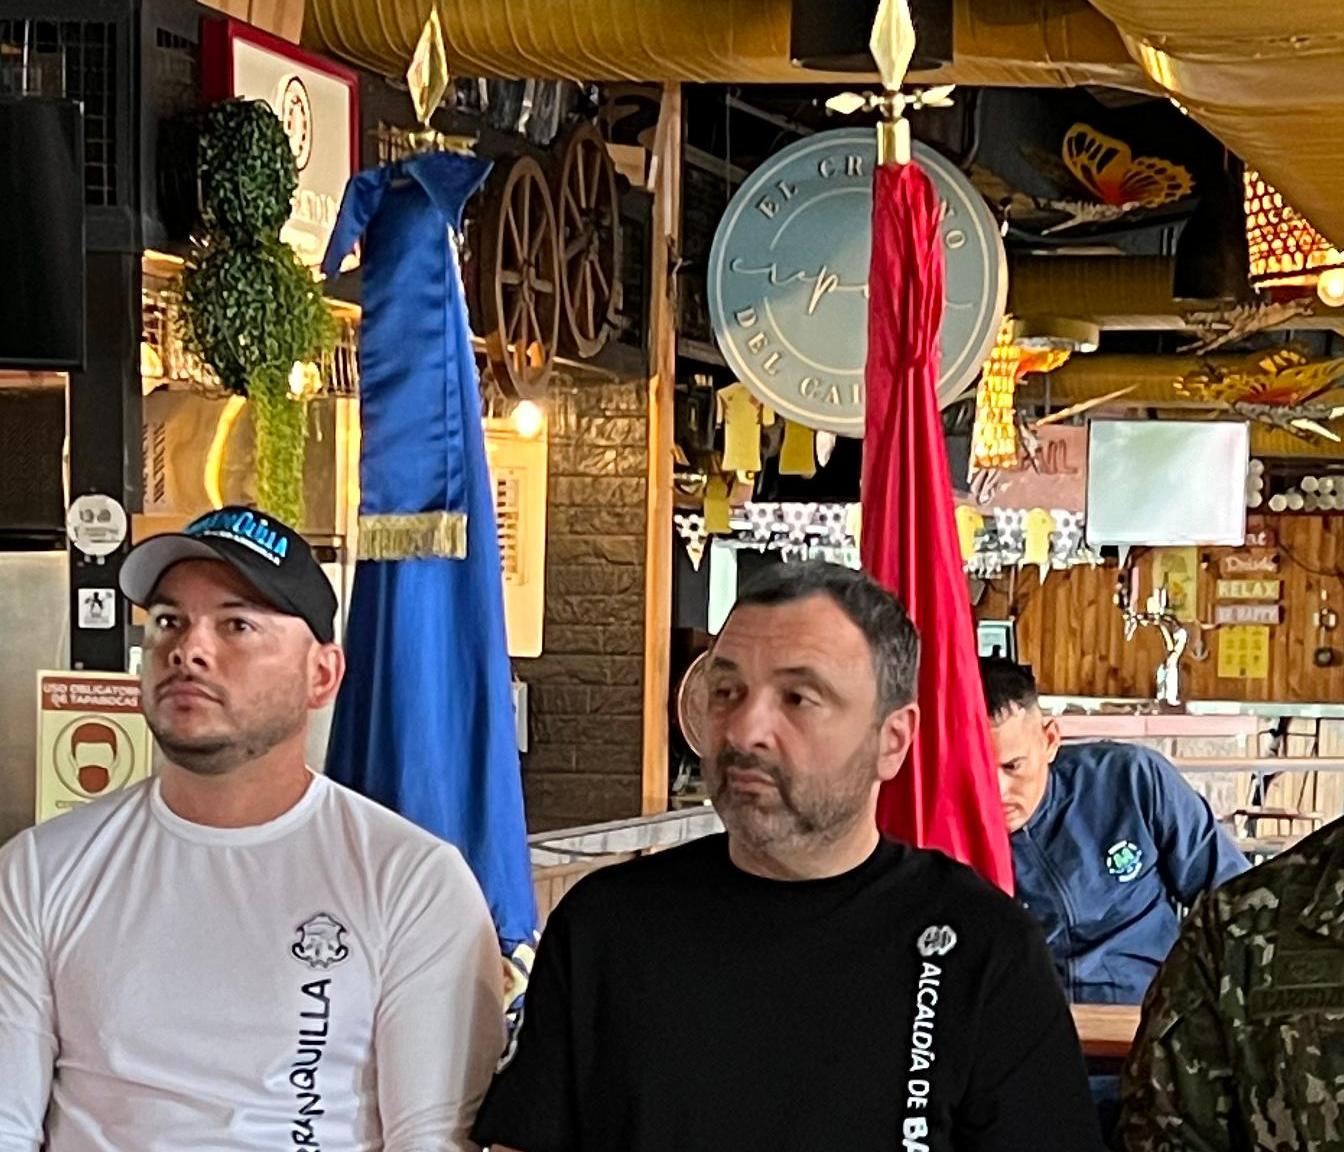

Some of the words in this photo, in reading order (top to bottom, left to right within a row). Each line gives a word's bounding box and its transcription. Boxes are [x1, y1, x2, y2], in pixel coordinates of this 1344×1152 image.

[756, 179, 799, 219] EL
[734, 305, 782, 376] DEL
[909, 961, 943, 1072] ALCALDÍA
[906, 1079, 930, 1109] DE
